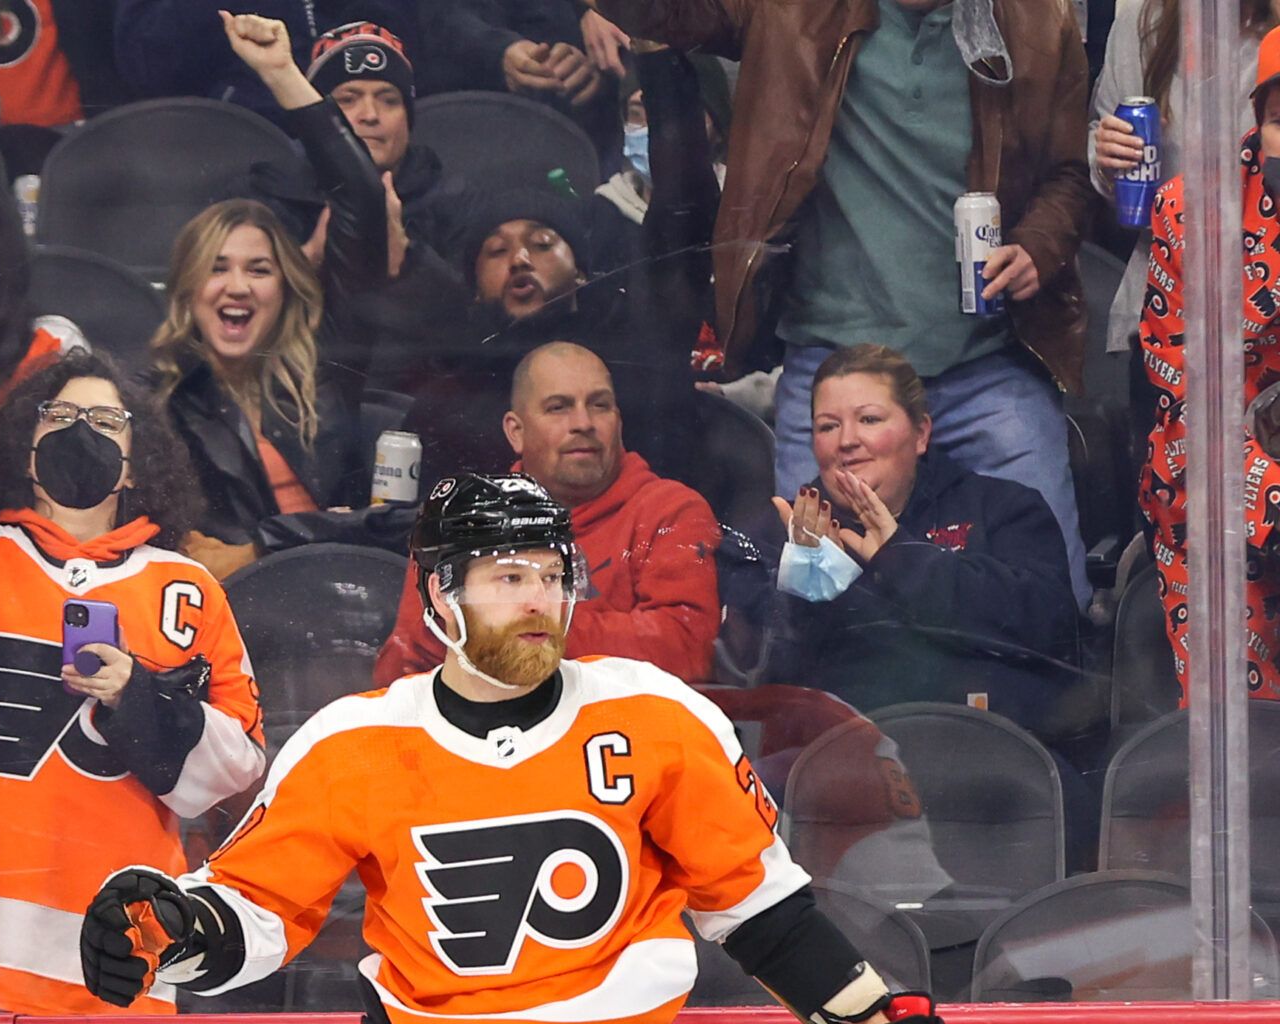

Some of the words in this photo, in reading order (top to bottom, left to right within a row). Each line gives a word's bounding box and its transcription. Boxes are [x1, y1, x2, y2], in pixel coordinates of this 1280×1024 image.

[1144, 348, 1184, 386] FLYERS
[1244, 456, 1269, 511] FLYERS
[159, 578, 204, 651] C
[582, 729, 636, 806] C
